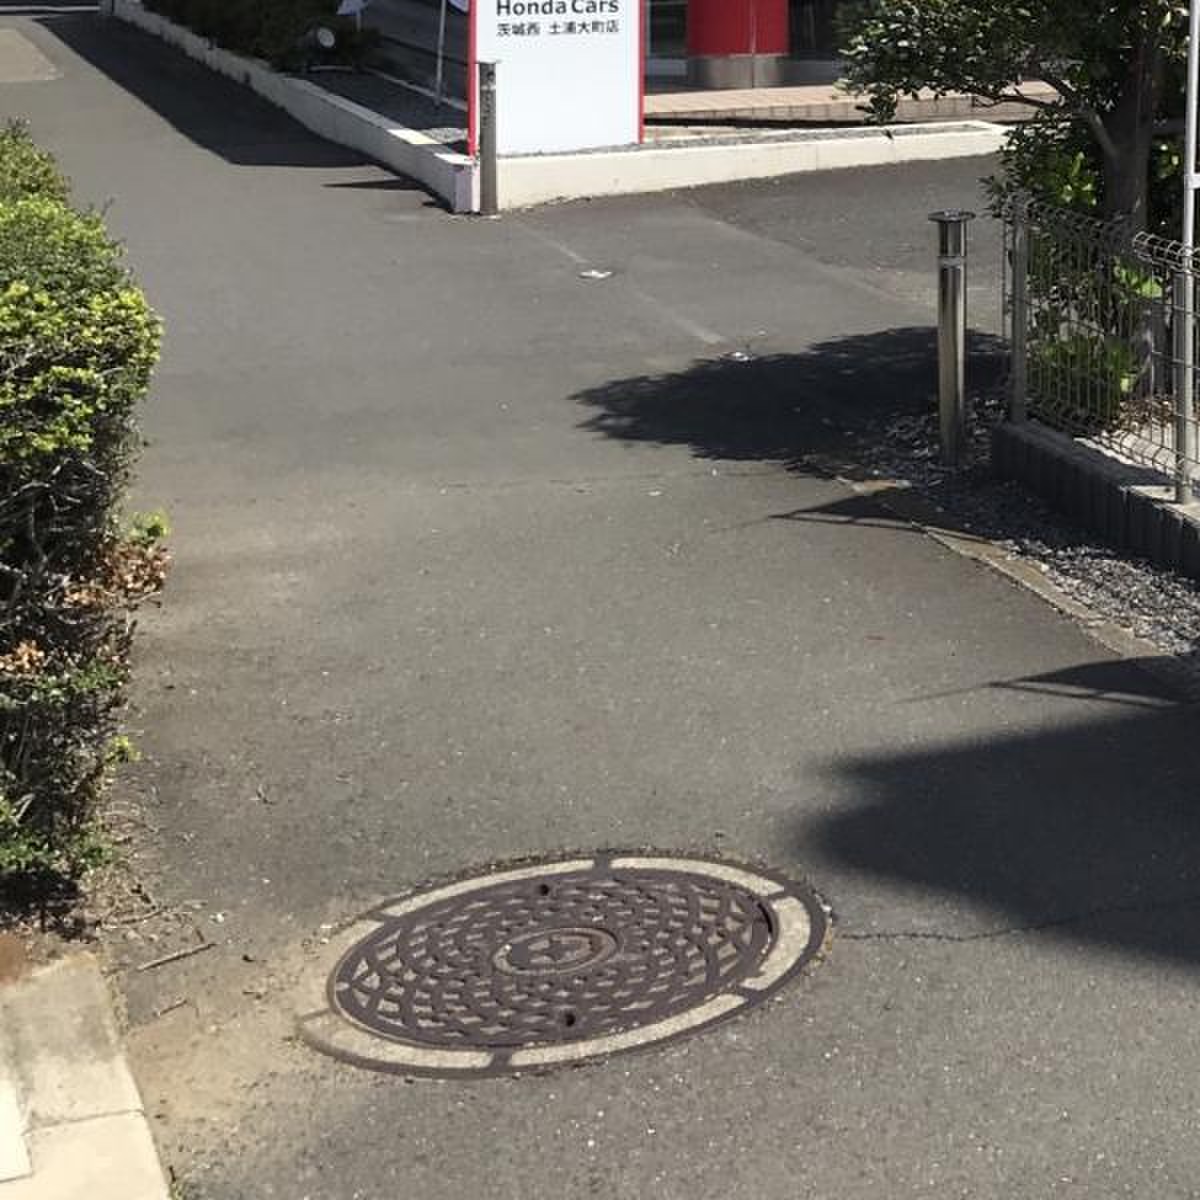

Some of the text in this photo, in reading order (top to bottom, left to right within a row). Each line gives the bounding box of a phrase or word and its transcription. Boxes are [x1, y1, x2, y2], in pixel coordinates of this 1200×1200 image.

[497, 19, 620, 37] 茨城西 土浦大町店
